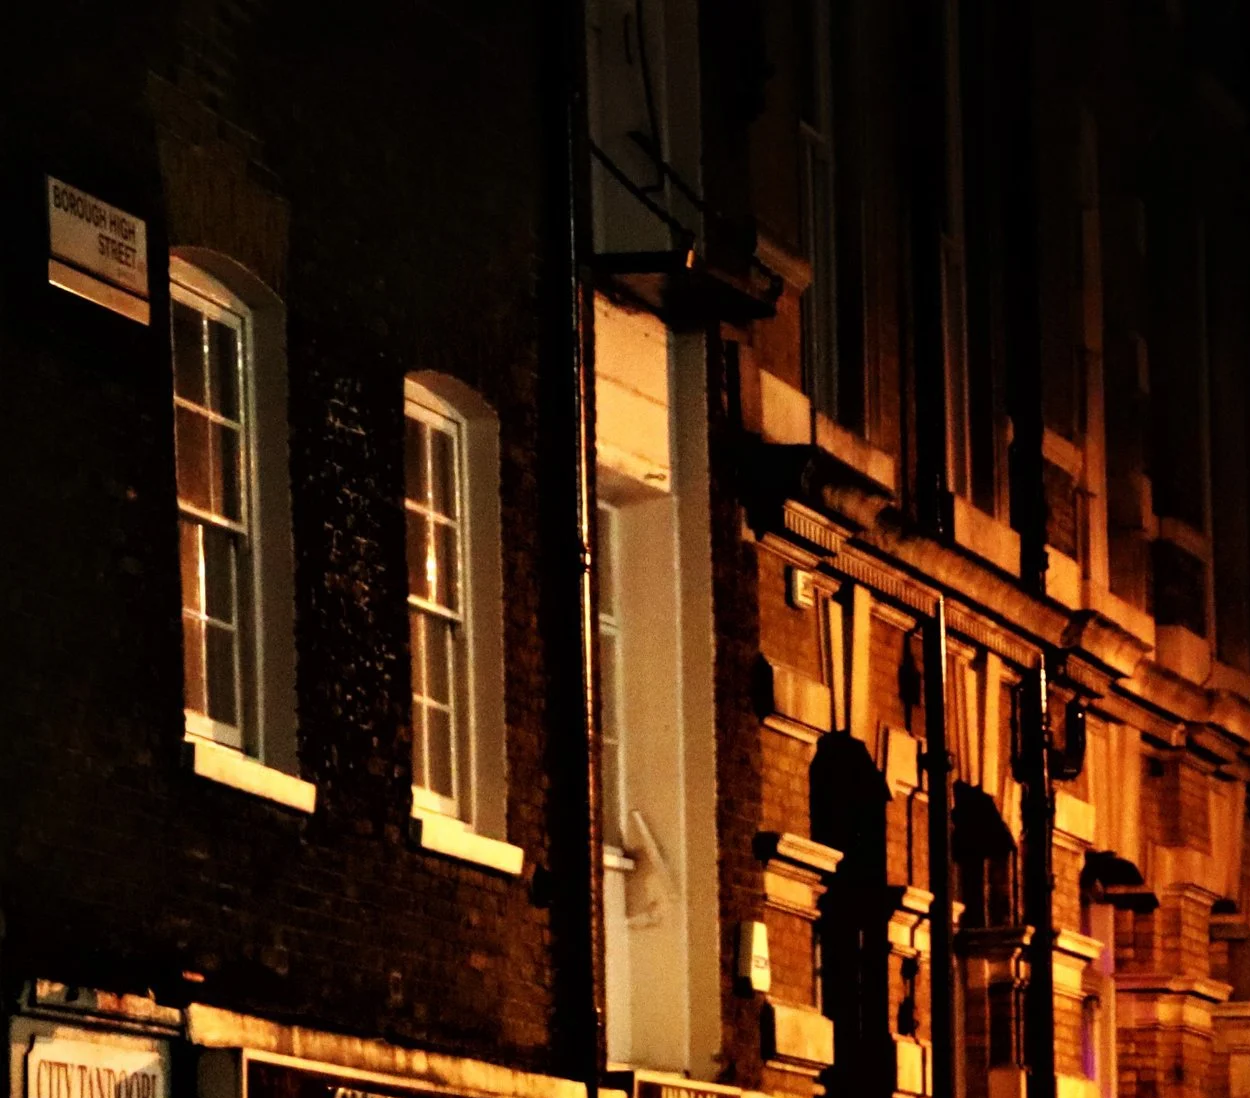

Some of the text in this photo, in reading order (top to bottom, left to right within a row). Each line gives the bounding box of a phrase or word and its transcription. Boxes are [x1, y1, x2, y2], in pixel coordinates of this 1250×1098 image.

[53, 184, 137, 245] BOROUGH HIGH
[98, 233, 138, 269] STREET
